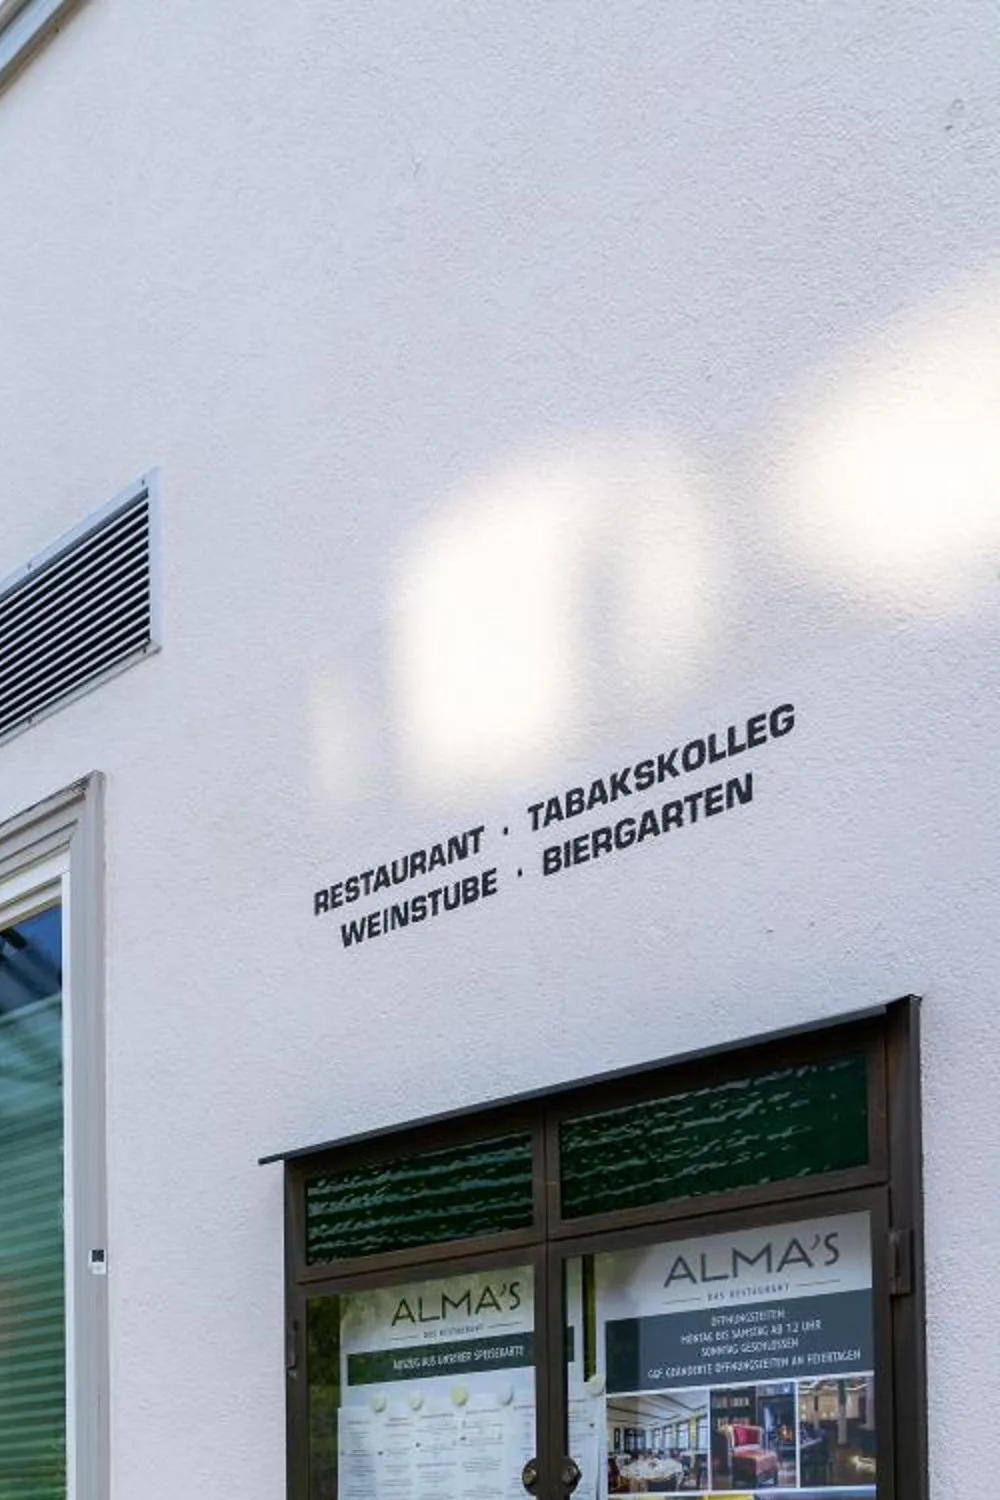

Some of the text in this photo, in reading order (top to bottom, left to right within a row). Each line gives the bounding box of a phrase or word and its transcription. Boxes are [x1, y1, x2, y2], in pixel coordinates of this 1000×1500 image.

[313, 703, 796, 916] RESTAURANT TABAKSKOLLEG
[341, 773, 754, 948] WEINSTUBE BIERGARTEN
[663, 1231, 841, 1288] ALMA'S
[391, 1282, 521, 1326] ALMA'S
[802, 1318, 822, 1331] UHR
